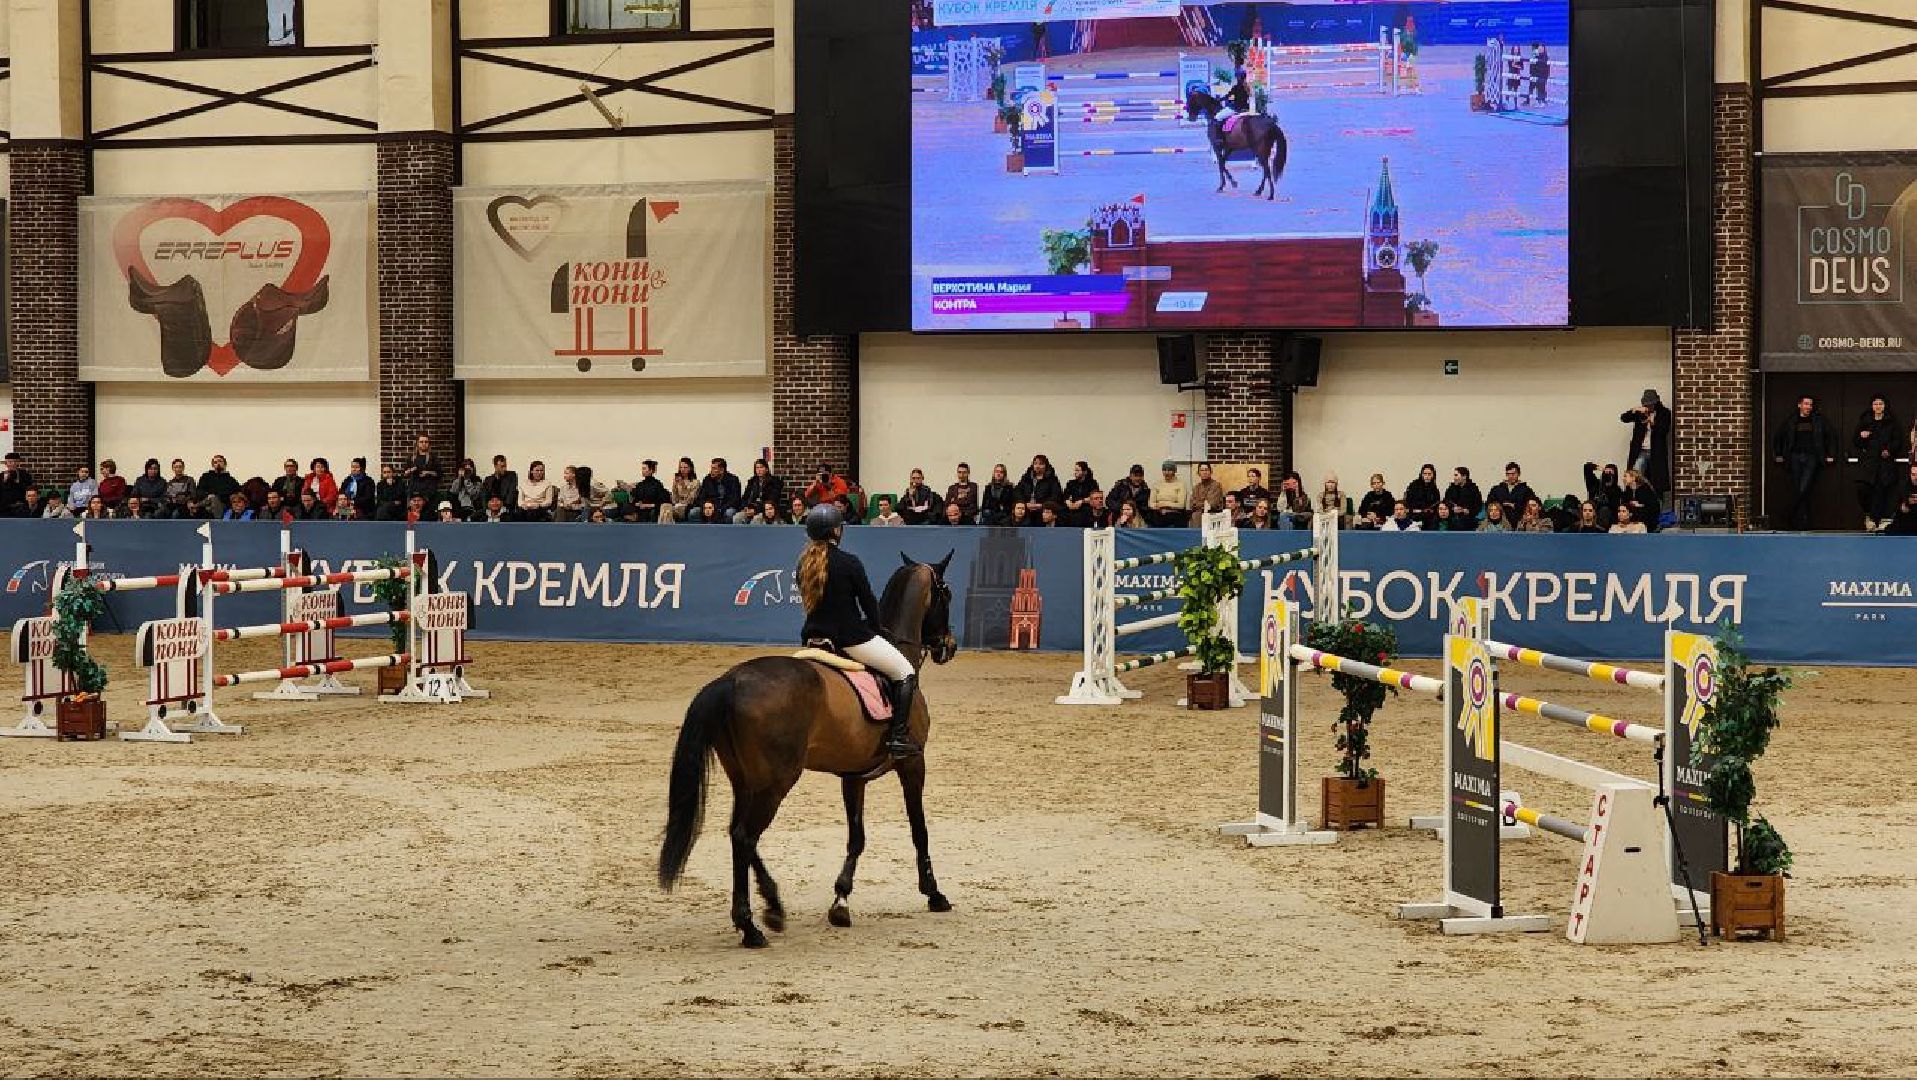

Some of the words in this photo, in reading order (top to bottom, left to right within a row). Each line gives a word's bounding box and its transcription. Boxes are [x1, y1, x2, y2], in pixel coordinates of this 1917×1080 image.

[154, 240, 294, 260] ERREPLUS
[1811, 227, 1891, 254] COSMO
[1809, 257, 1891, 293] DEUS
[933, 283, 995, 293] ВЕРХОТИНА
[998, 283, 1032, 294] Мария
[933, 299, 977, 310] КОНТРА
[1818, 337, 1902, 348] COSMO-DEUS.RU
[473, 560, 686, 609] КРЕМЛЯ
[1829, 581, 1914, 597] MAXIMA
[1484, 572, 1748, 625] КРЕМЛЯ
[1855, 613, 1886, 621] PARK
[429, 679, 441, 697] 12
[1454, 771, 1491, 797] MAXIMA
[1575, 794, 1607, 936] СТАРТ
